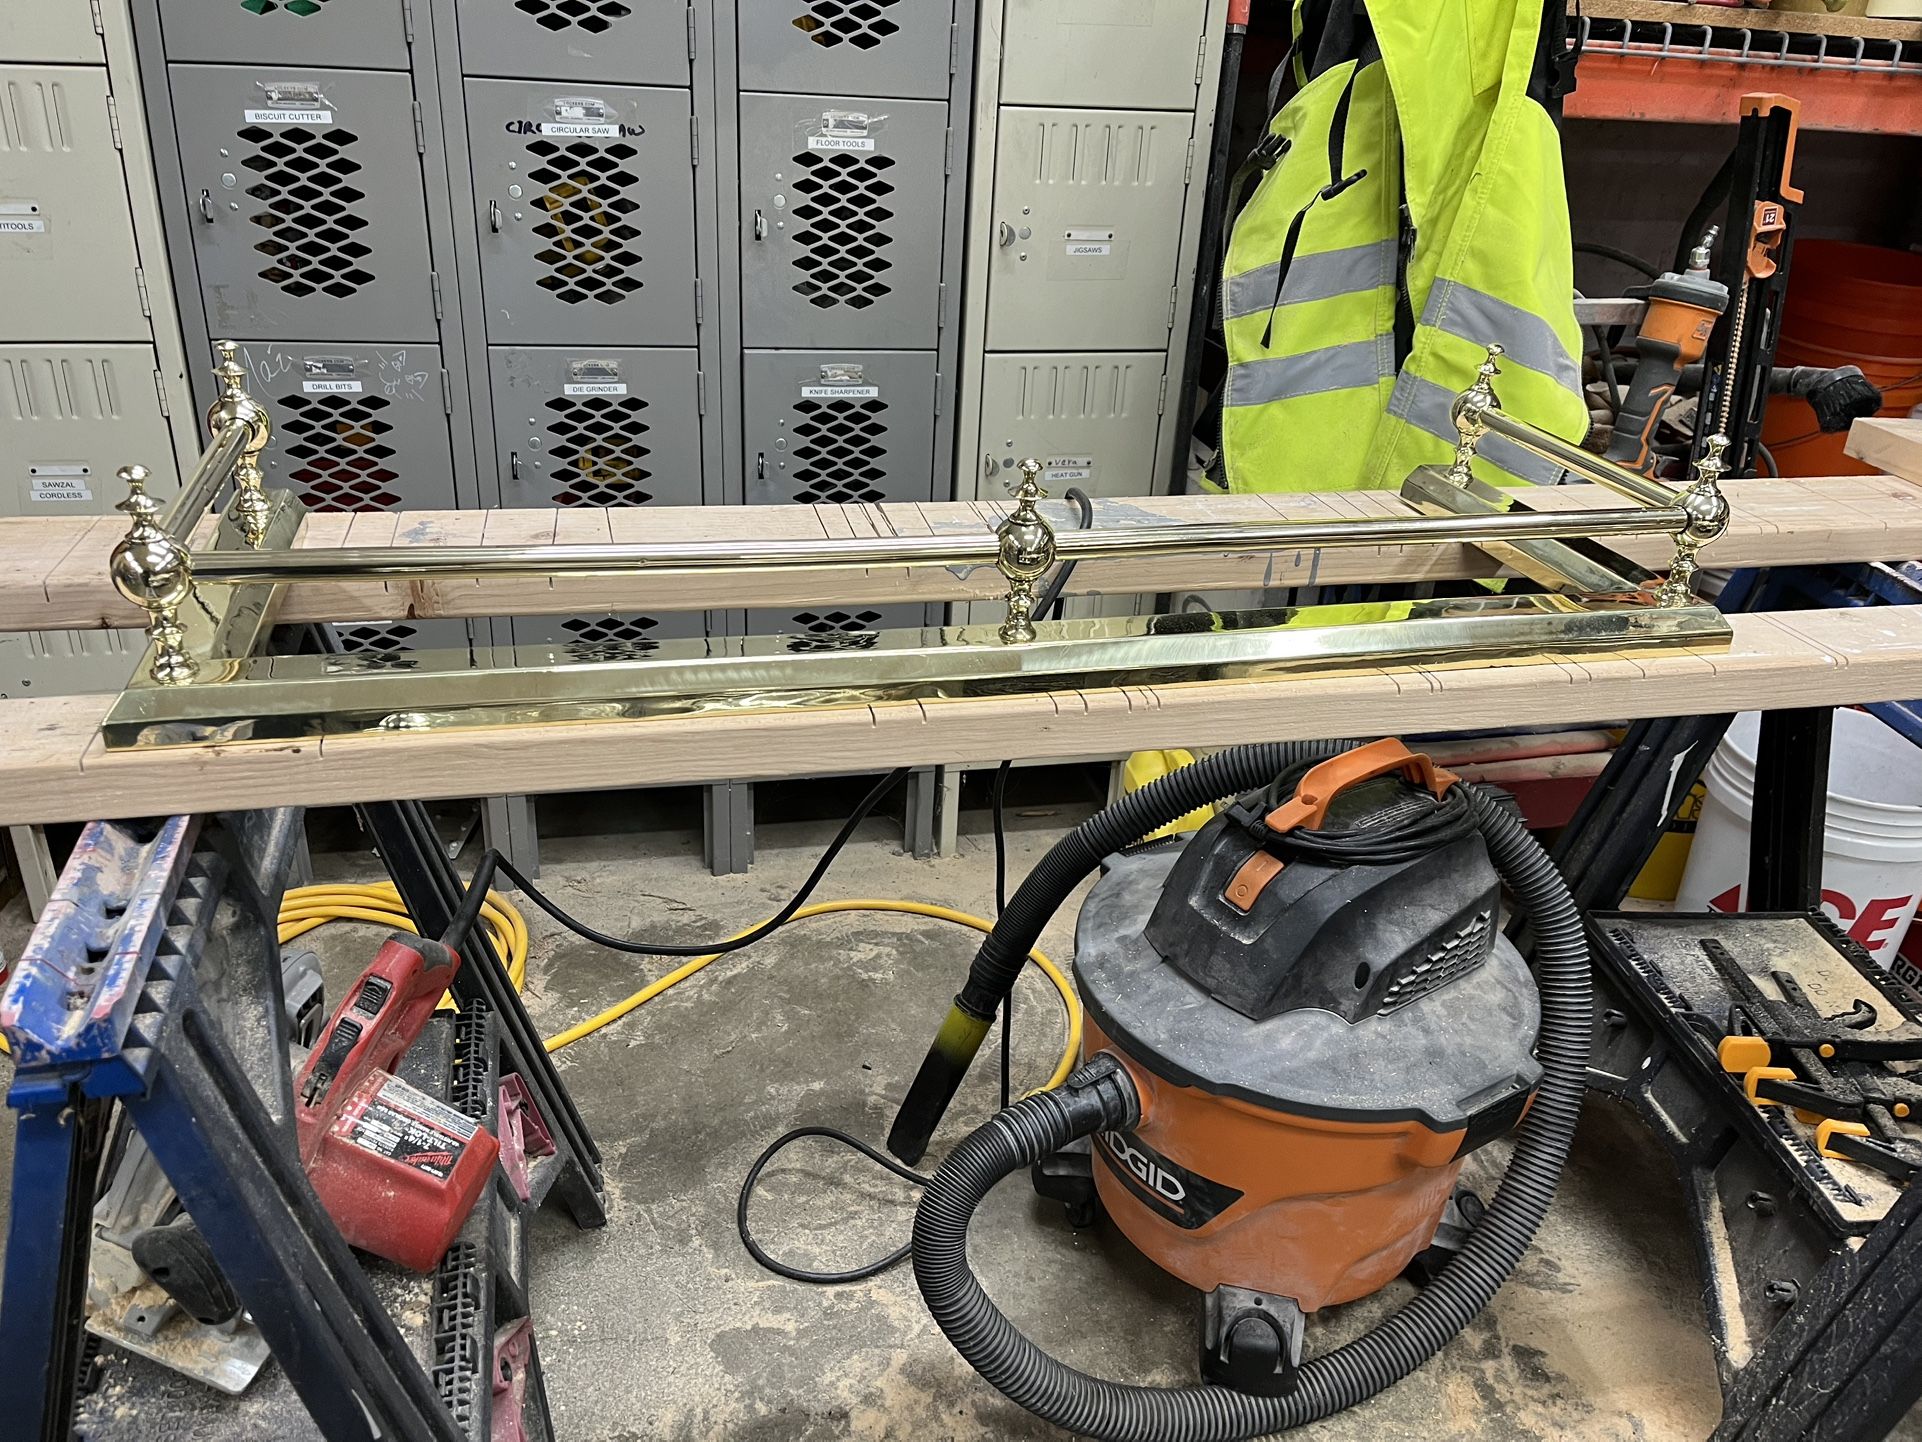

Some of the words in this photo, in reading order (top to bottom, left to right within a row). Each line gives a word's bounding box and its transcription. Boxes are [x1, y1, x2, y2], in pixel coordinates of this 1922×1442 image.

[551, 126, 590, 134] CIRCULAR
[592, 126, 610, 134] SAW
[815, 139, 840, 147] FLOOR
[1073, 246, 1103, 254] JIGSAWS
[311, 383, 334, 391] DRILL
[335, 383, 353, 391] BITS
[406, 1153, 453, 1166] Milwaukee
[1102, 1131, 1186, 1201] IDGID
